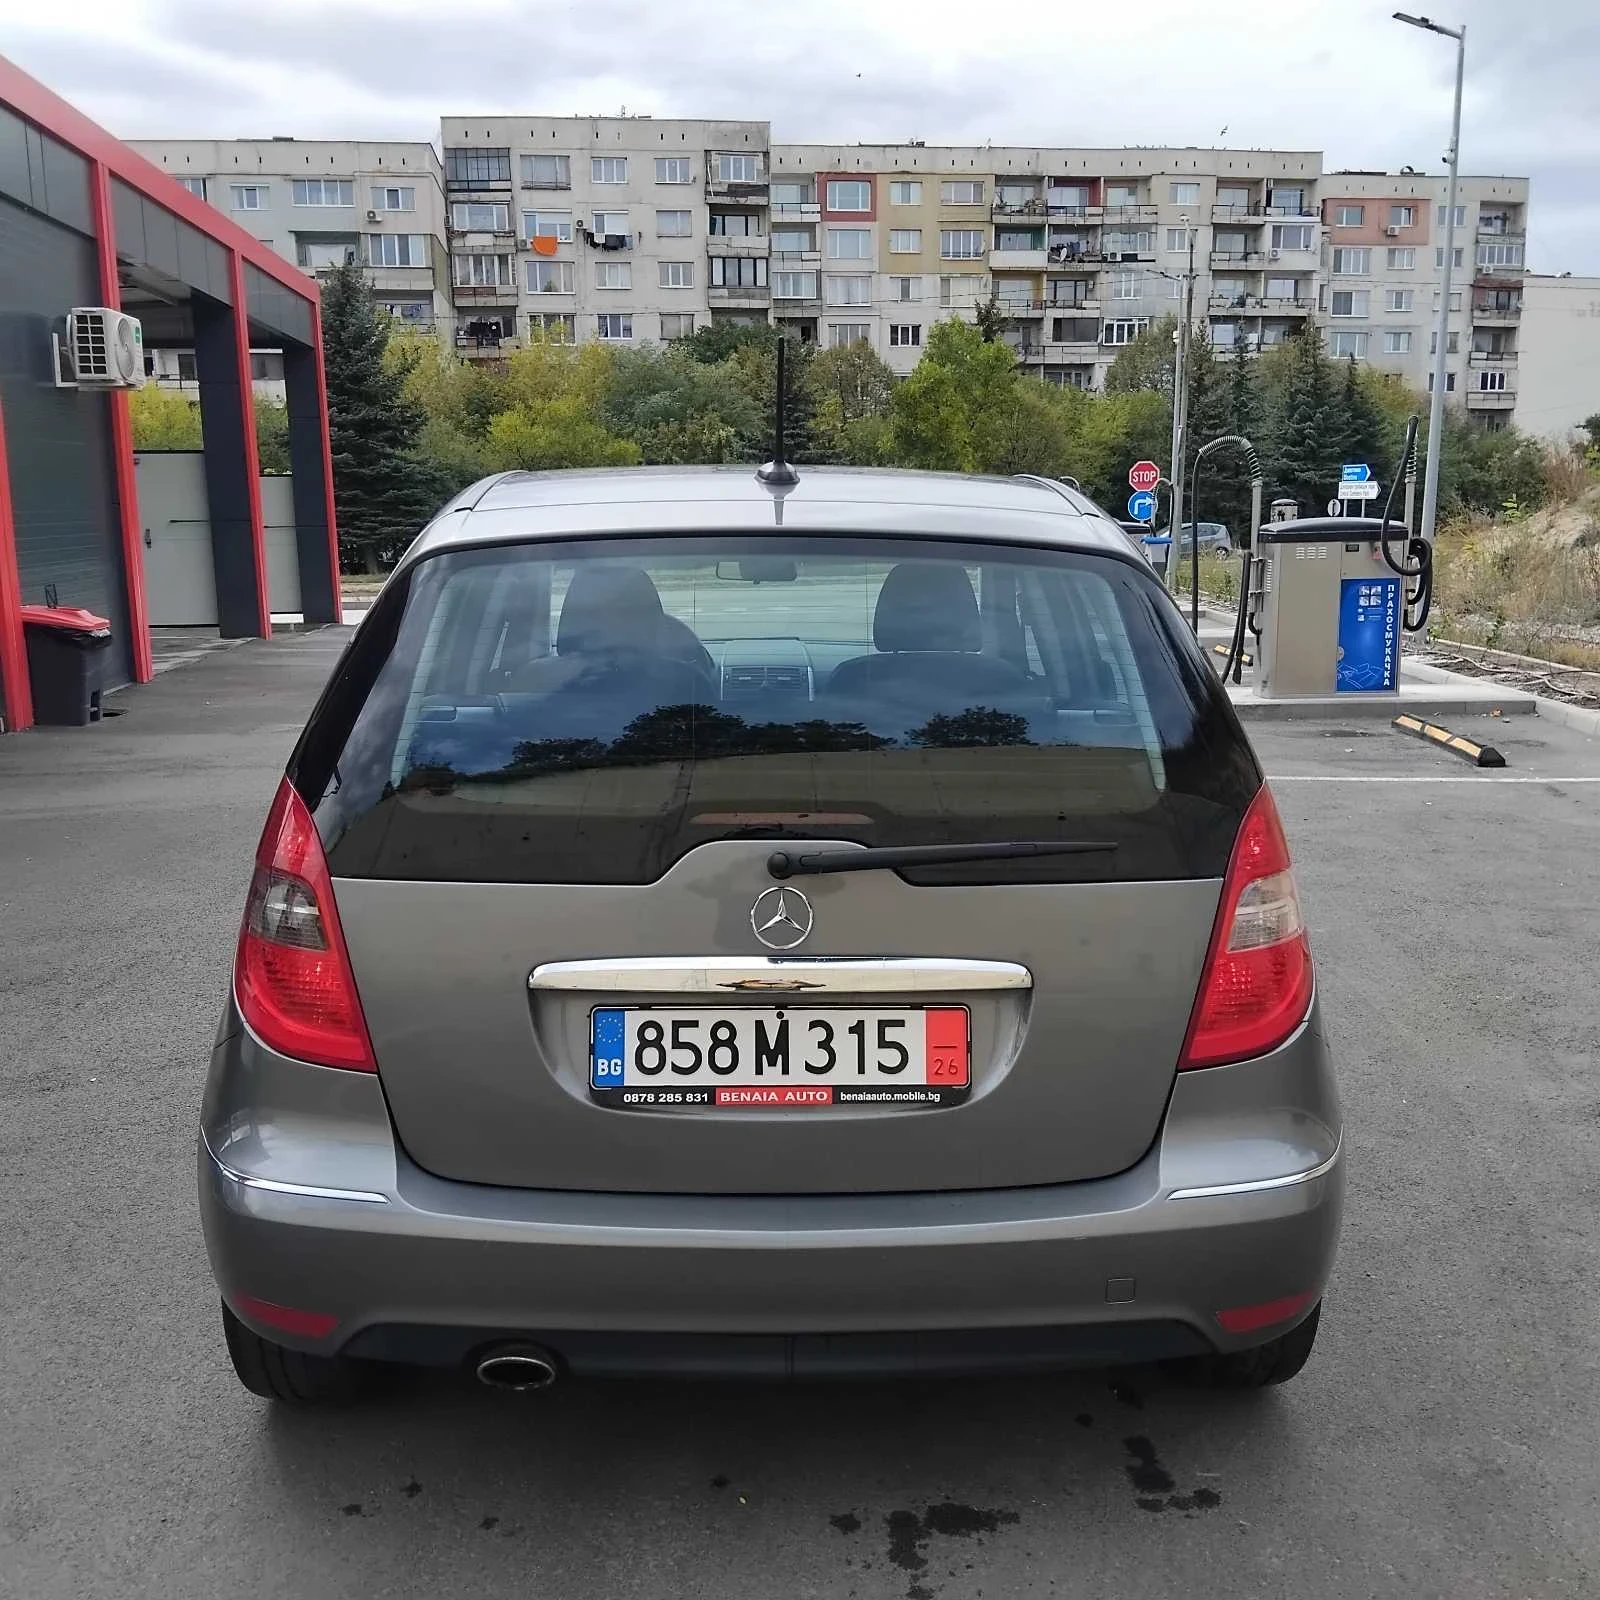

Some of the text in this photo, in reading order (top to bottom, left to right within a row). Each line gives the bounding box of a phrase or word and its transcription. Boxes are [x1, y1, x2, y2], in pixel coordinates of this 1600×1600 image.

[1132, 471, 1157, 482] STOP
[1383, 584, 1395, 686] ПРАХОСМУКАЧКА
[635, 1019, 909, 1075] 858 M 315
[597, 1058, 622, 1076] BG
[933, 1058, 958, 1075] 26
[623, 1092, 708, 1103] 0878 285 831
[720, 1091, 828, 1102] BENAIA AUTO
[840, 1091, 941, 1103] benaiaauto.mobile.bg
